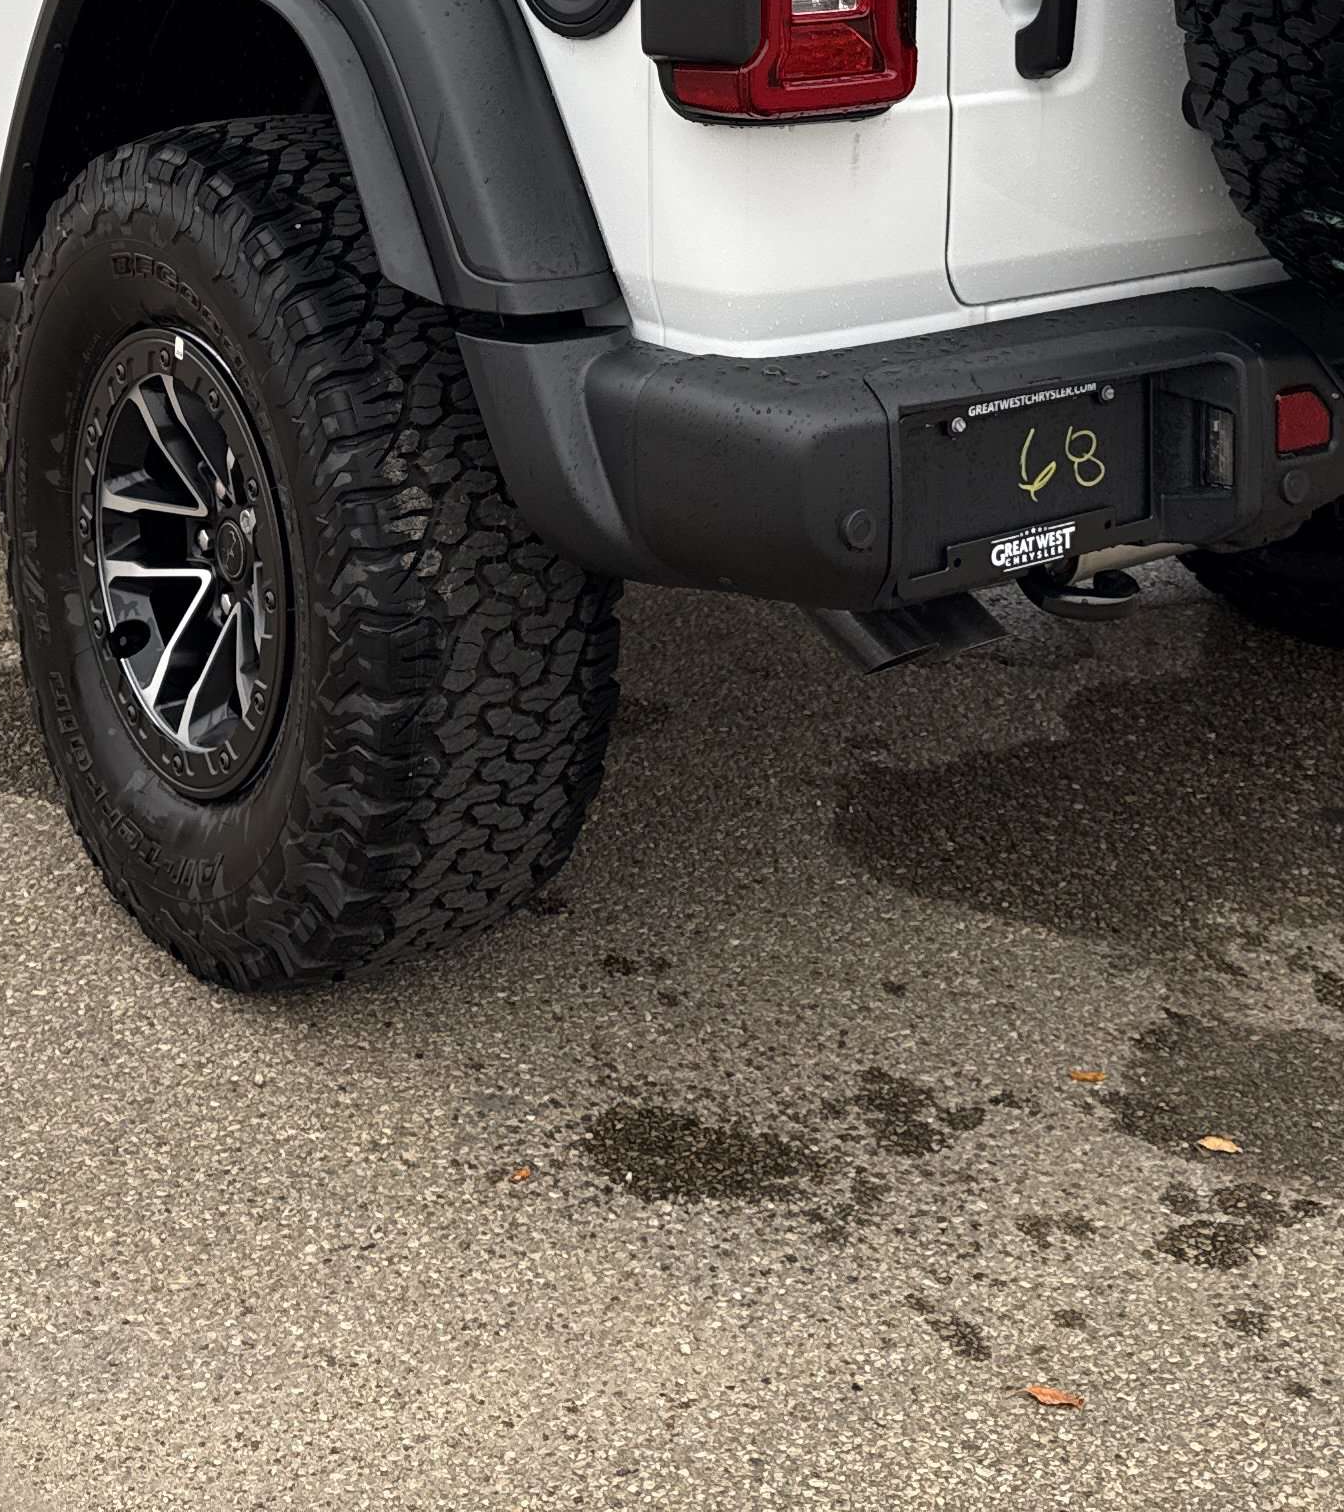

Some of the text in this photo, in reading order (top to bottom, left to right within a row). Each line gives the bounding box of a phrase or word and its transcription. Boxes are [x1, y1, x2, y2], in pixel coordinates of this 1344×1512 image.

[968, 382, 1096, 417] GREATWESTCHRYSLER.COM
[1018, 425, 1105, 502] 68
[991, 526, 1075, 566] GREAT WEST
[1005, 545, 1063, 566] CHRYSLER
